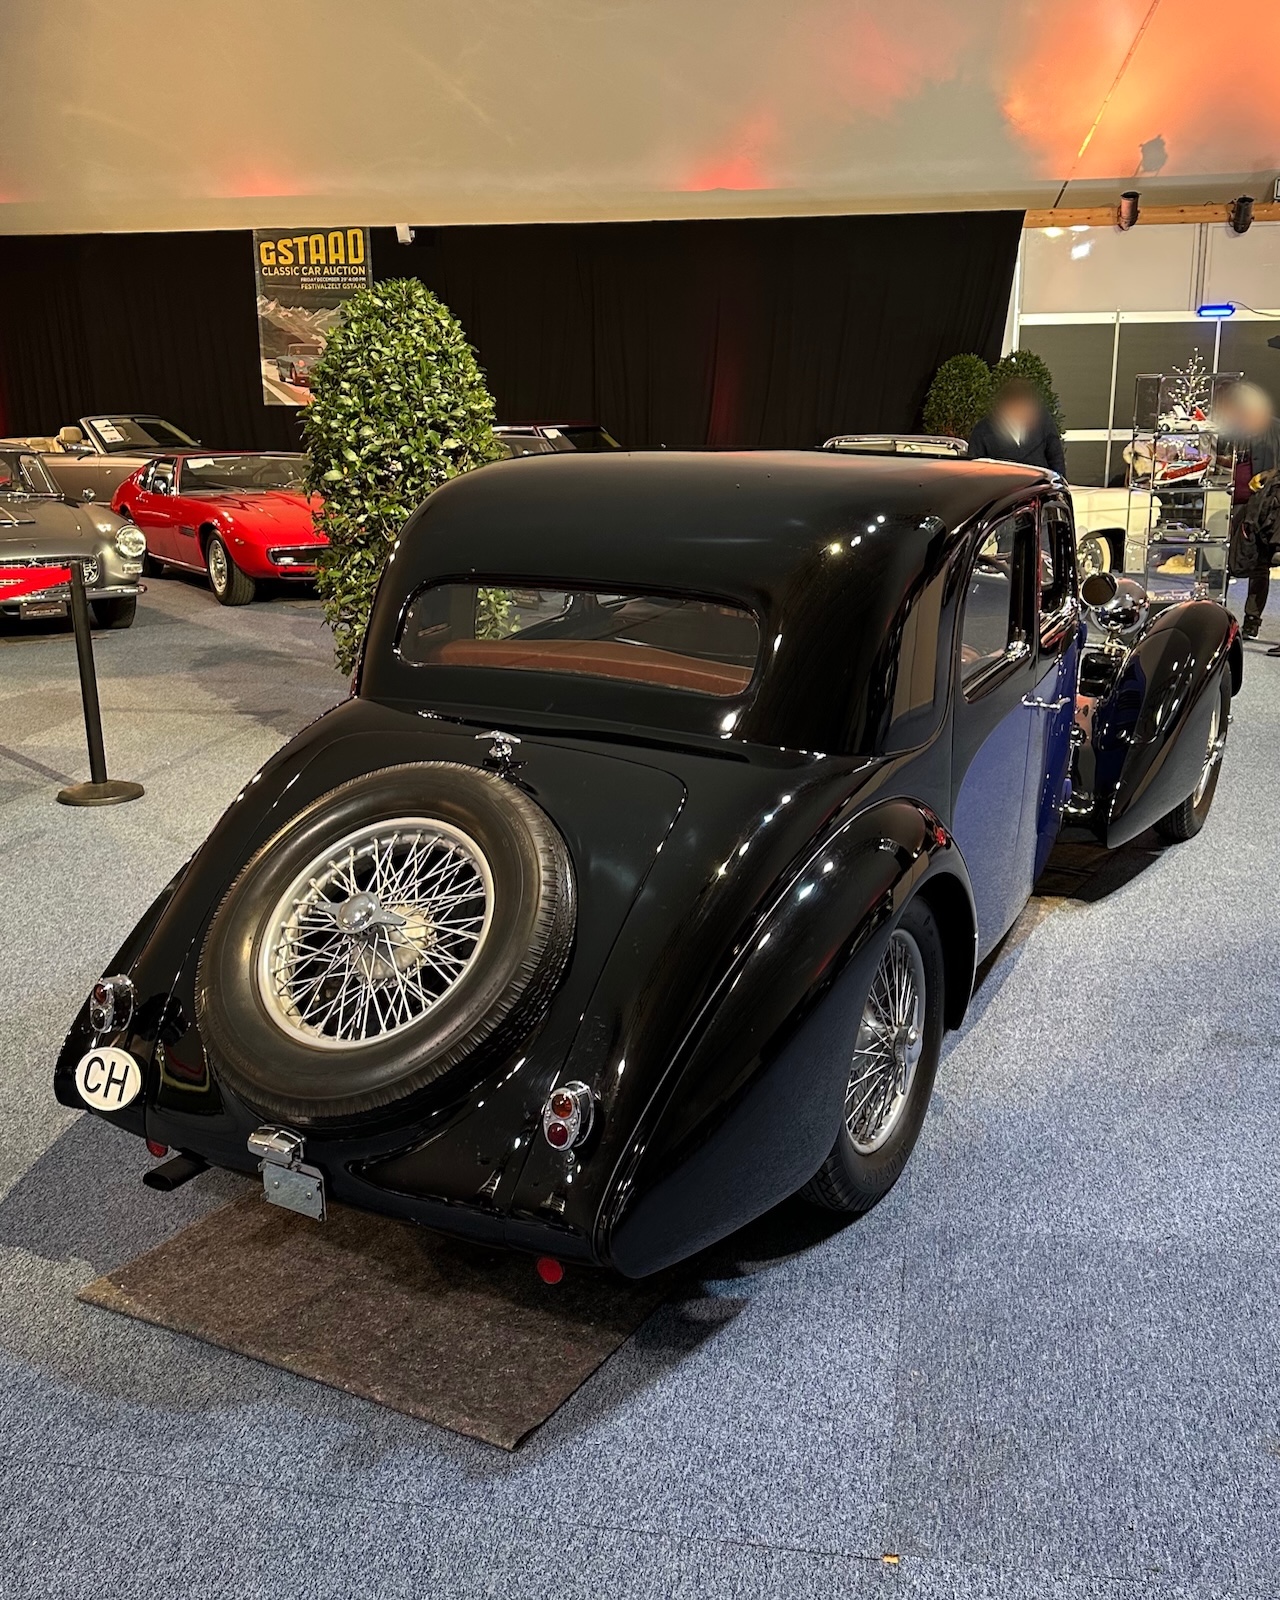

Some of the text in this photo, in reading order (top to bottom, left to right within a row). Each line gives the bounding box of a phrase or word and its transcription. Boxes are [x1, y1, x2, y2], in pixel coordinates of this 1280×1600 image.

[260, 228, 364, 265] GSTAAD
[262, 266, 366, 276] CLASSIC CAR AUCTION
[83, 1056, 130, 1103] CH
